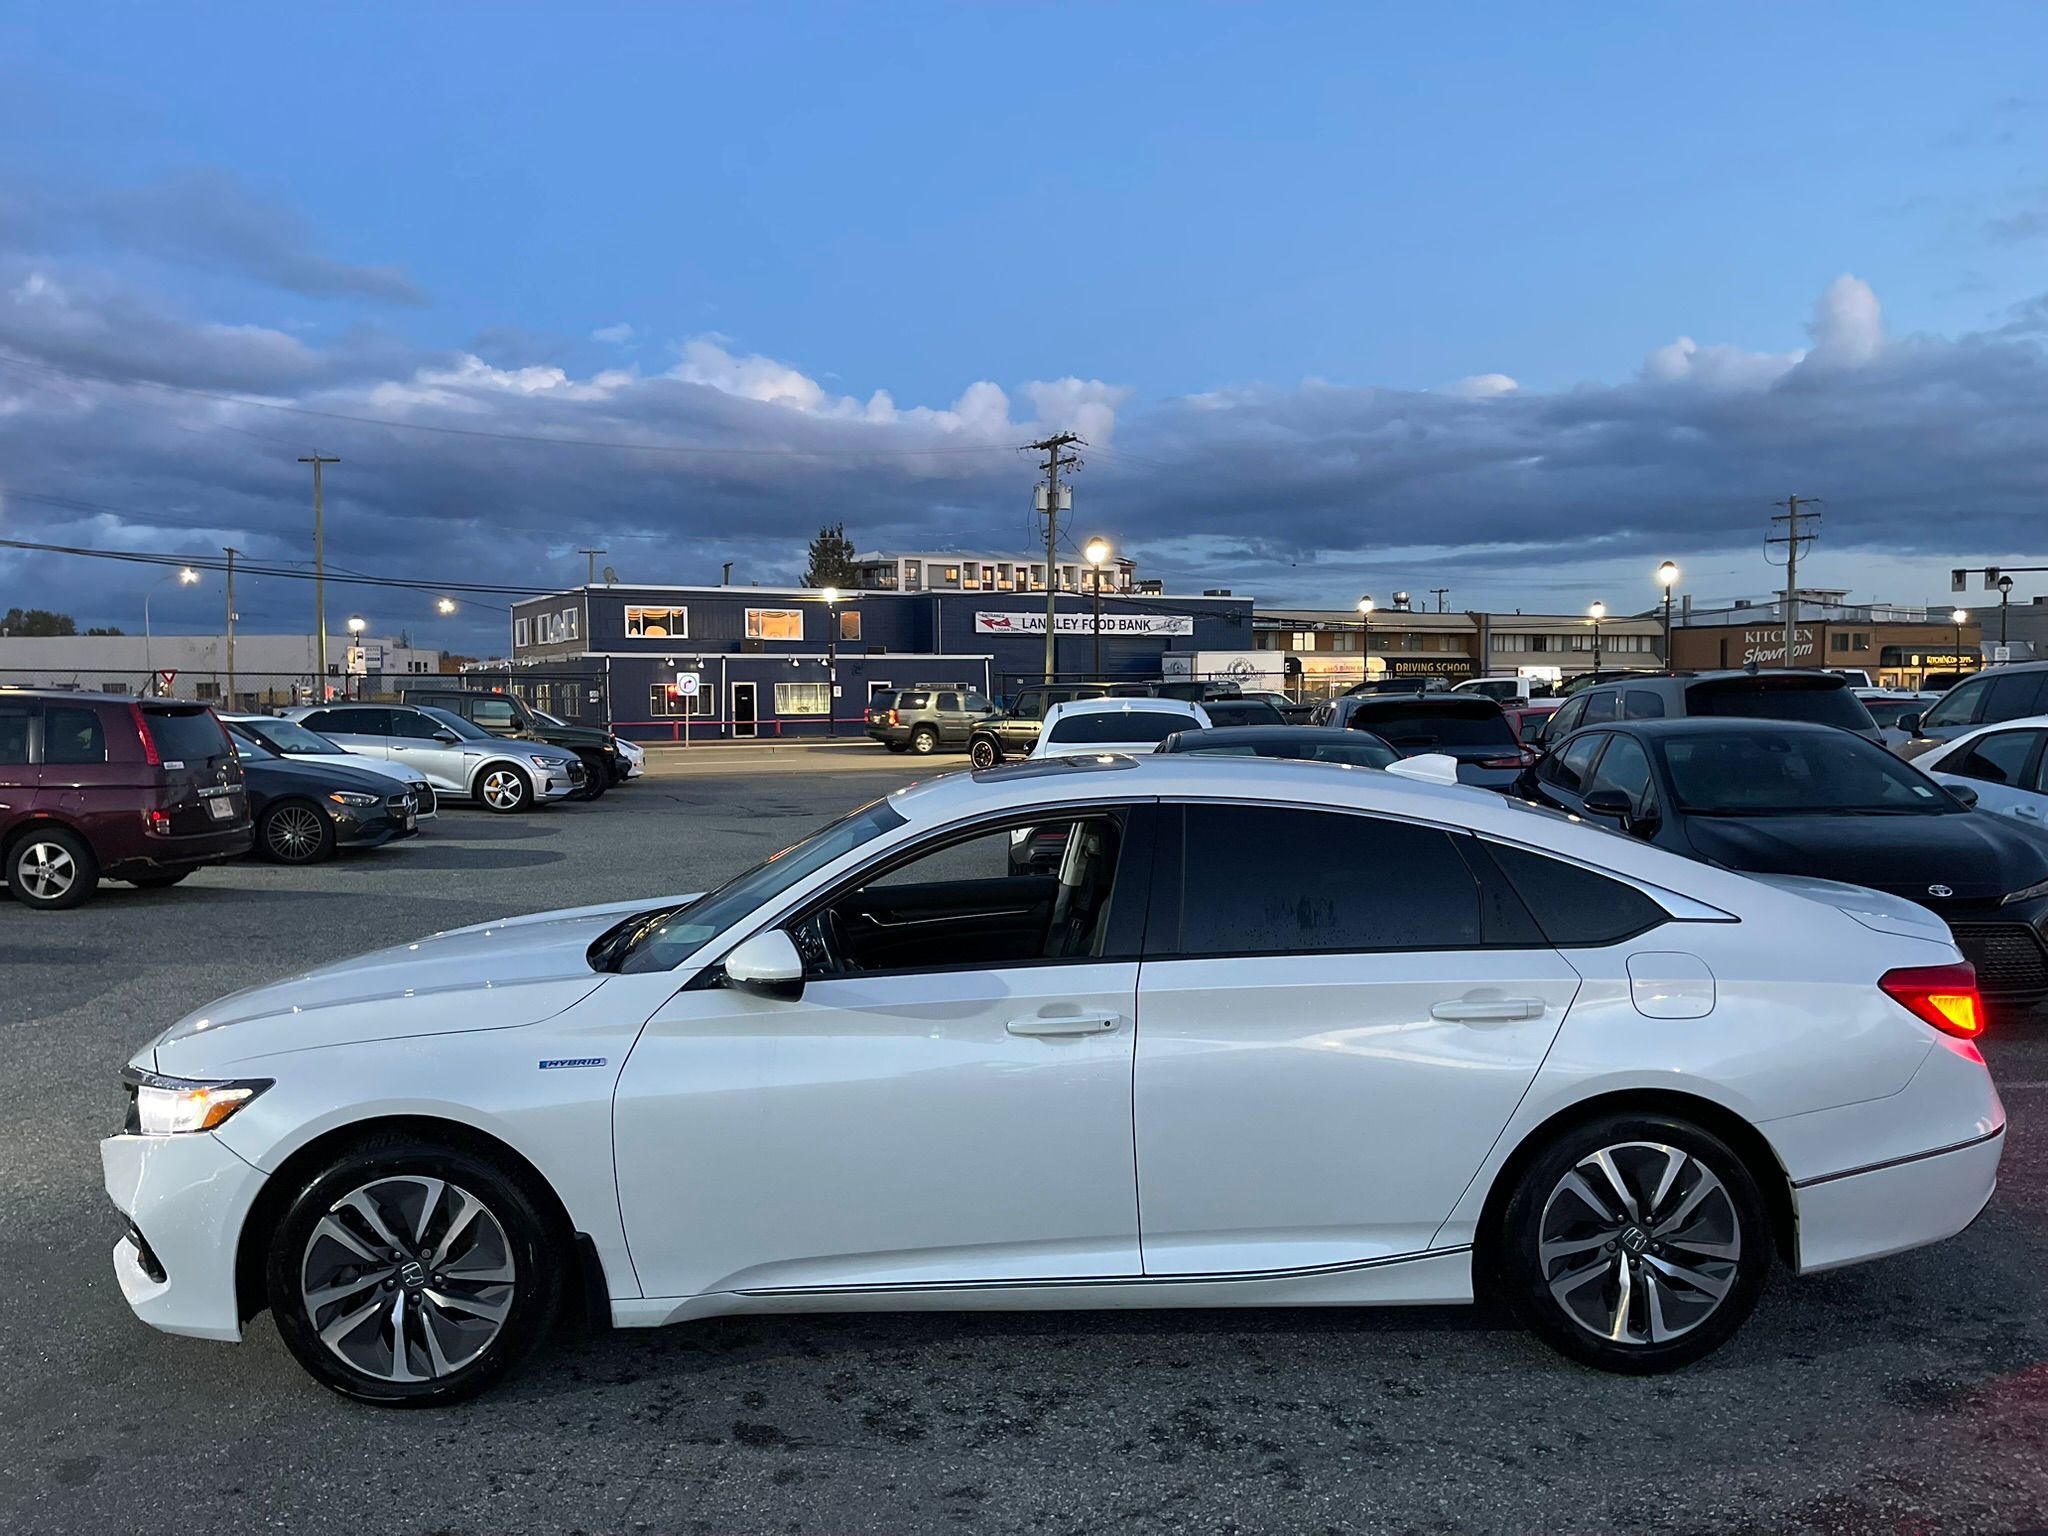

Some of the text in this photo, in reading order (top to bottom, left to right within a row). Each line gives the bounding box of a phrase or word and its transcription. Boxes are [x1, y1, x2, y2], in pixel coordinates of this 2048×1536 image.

[1022, 617, 1078, 630] LANLEY
[1119, 619, 1151, 631] BANK
[1743, 643, 1813, 665] Showrom
[1396, 662, 1470, 672] DRIVING SCHOOL
[548, 1059, 602, 1067] HYBRID
